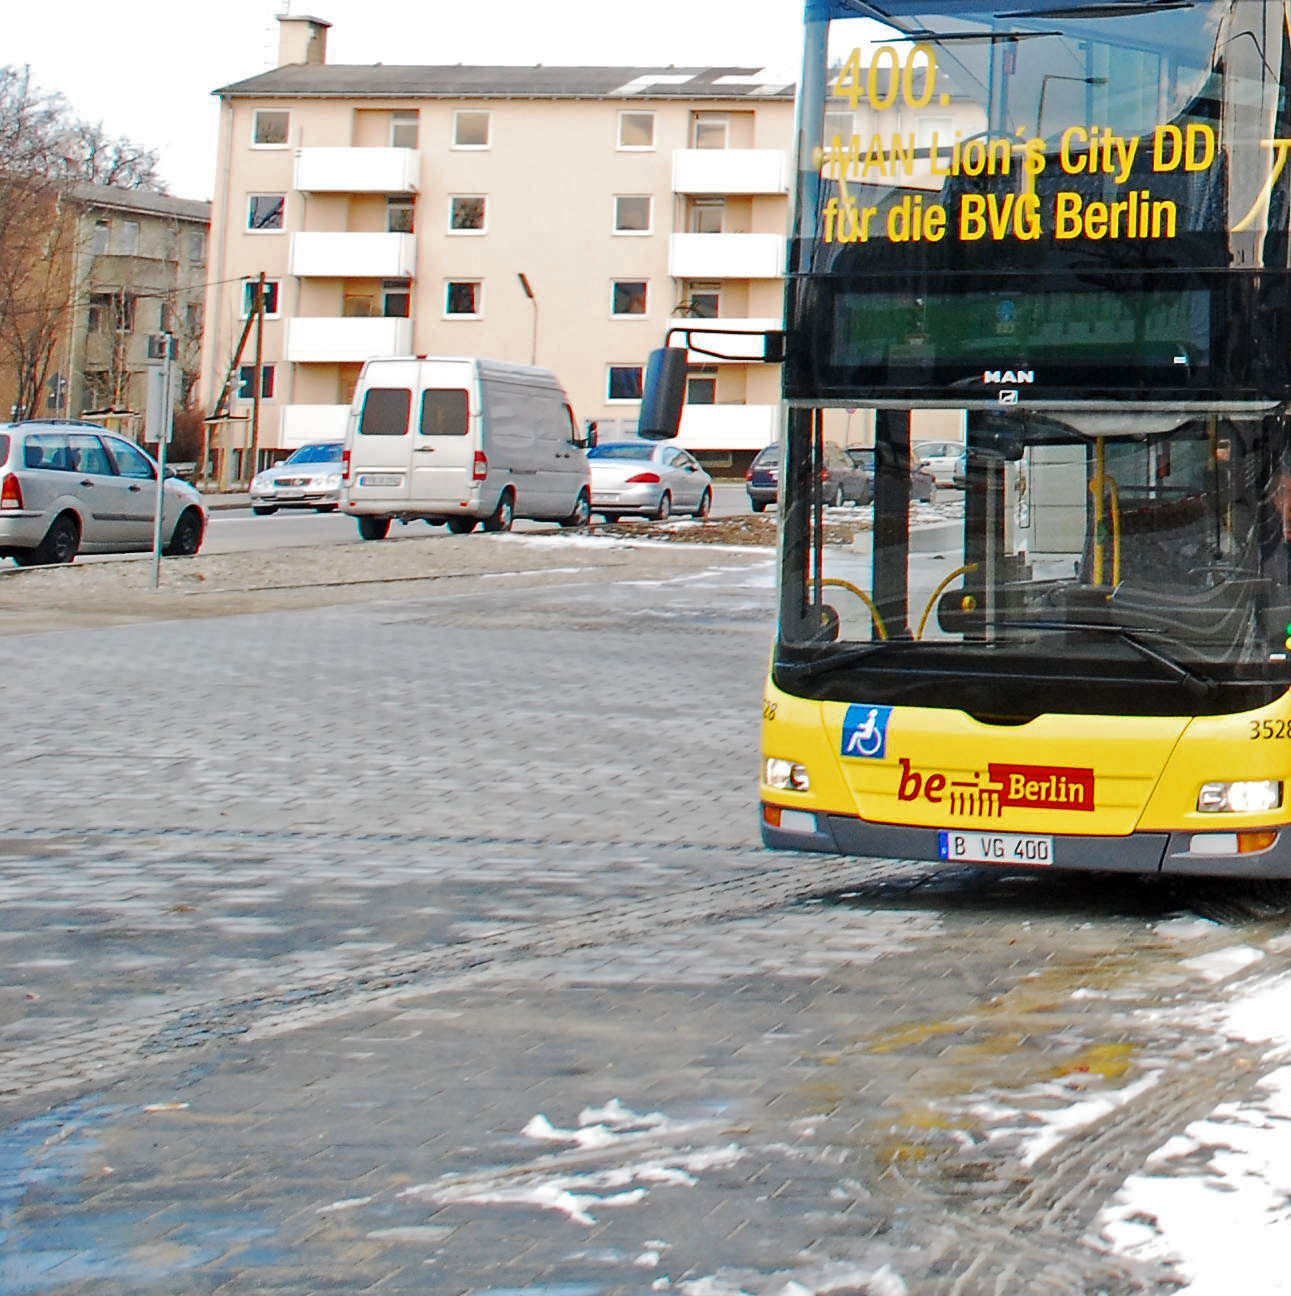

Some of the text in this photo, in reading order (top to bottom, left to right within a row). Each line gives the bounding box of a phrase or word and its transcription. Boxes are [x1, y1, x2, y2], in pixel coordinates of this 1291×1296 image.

[834, 43, 951, 110] 400.
[831, 133, 915, 177] MAN
[1061, 125, 1140, 184] City
[1153, 124, 1215, 172] DD
[823, 190, 1177, 243] für die BVG Berlin
[983, 370, 1035, 384] MAN
[898, 757, 1085, 803] be Berlin
[954, 836, 1048, 860] B VG 400
